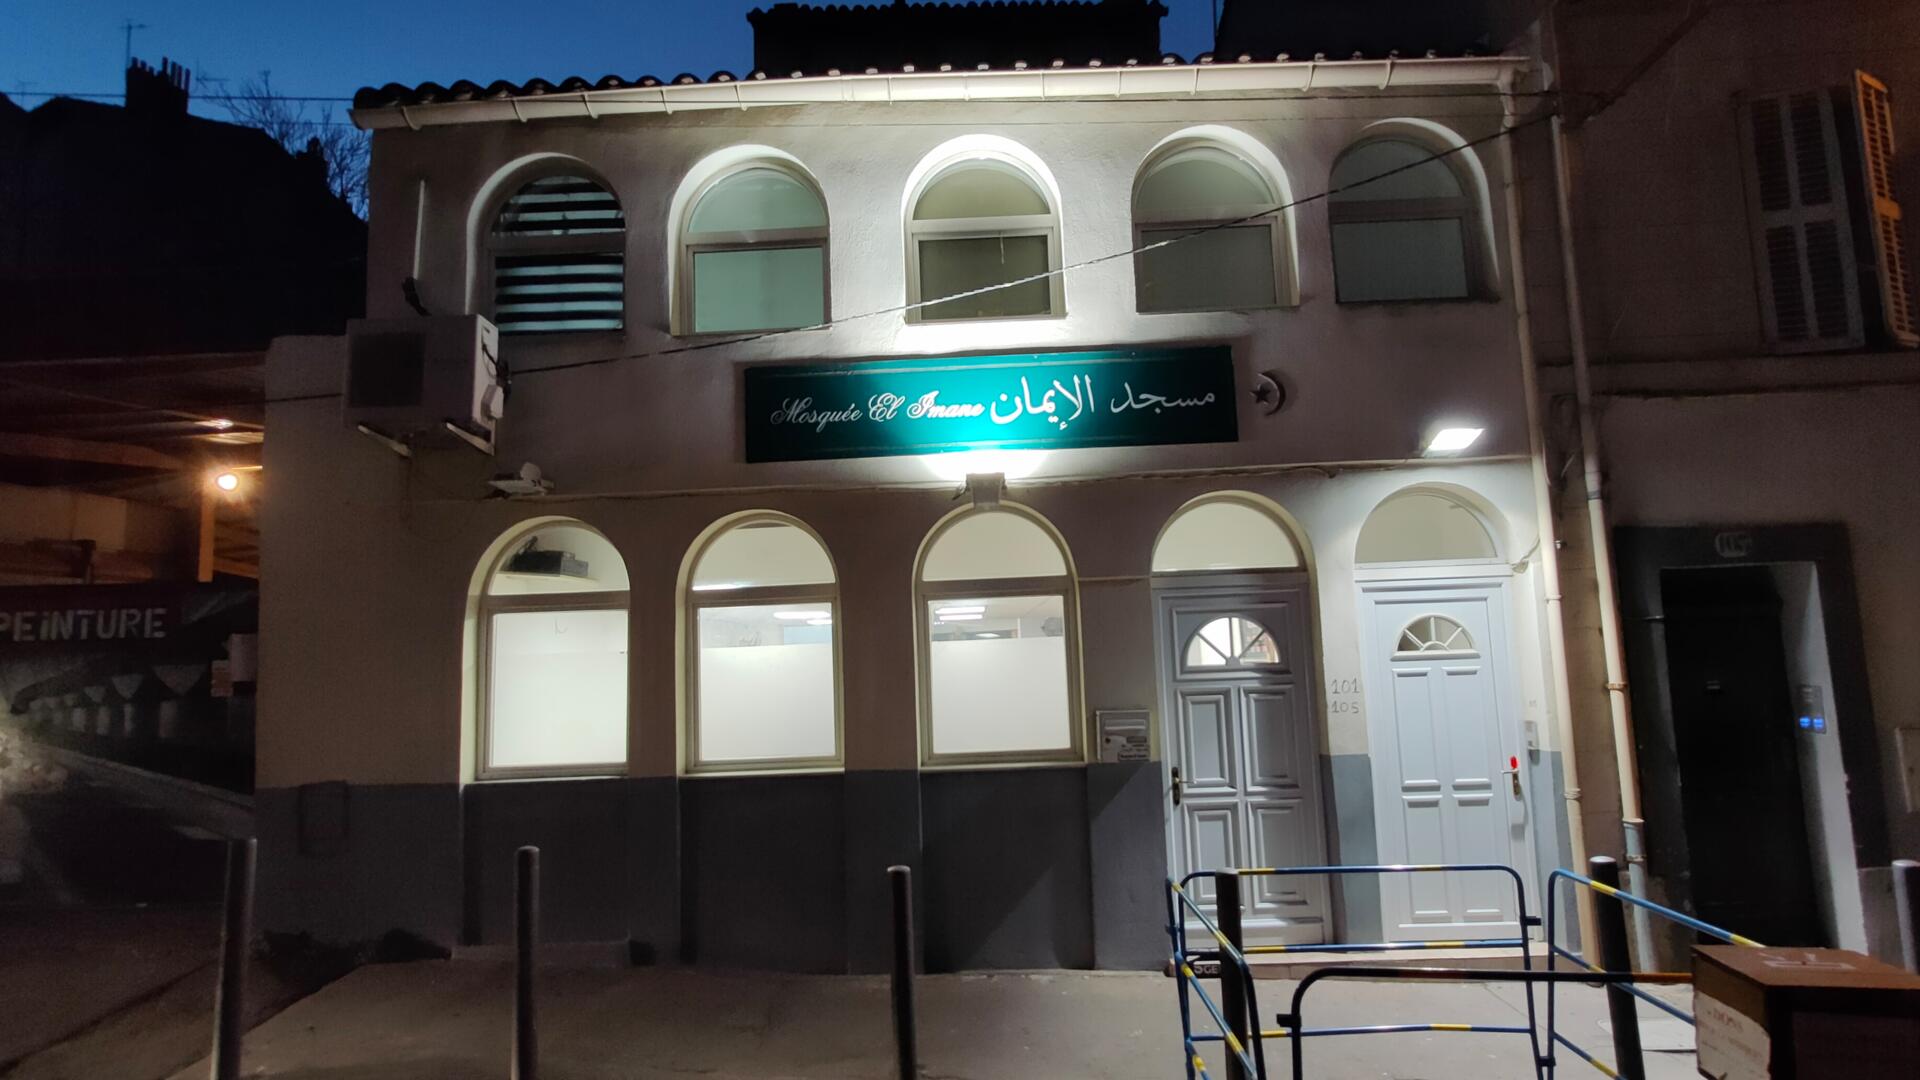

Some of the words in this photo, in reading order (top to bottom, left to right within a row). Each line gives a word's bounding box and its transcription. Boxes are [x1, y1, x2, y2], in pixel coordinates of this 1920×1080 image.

[770, 396, 863, 433] Mosquée
[868, 392, 905, 422] El
[906, 390, 985, 419] Imane
[989, 373, 1095, 431] الإيمان
[1110, 381, 1216, 415] مسجد
[1331, 677, 1360, 694] 101
[1331, 700, 1359, 714] 105
